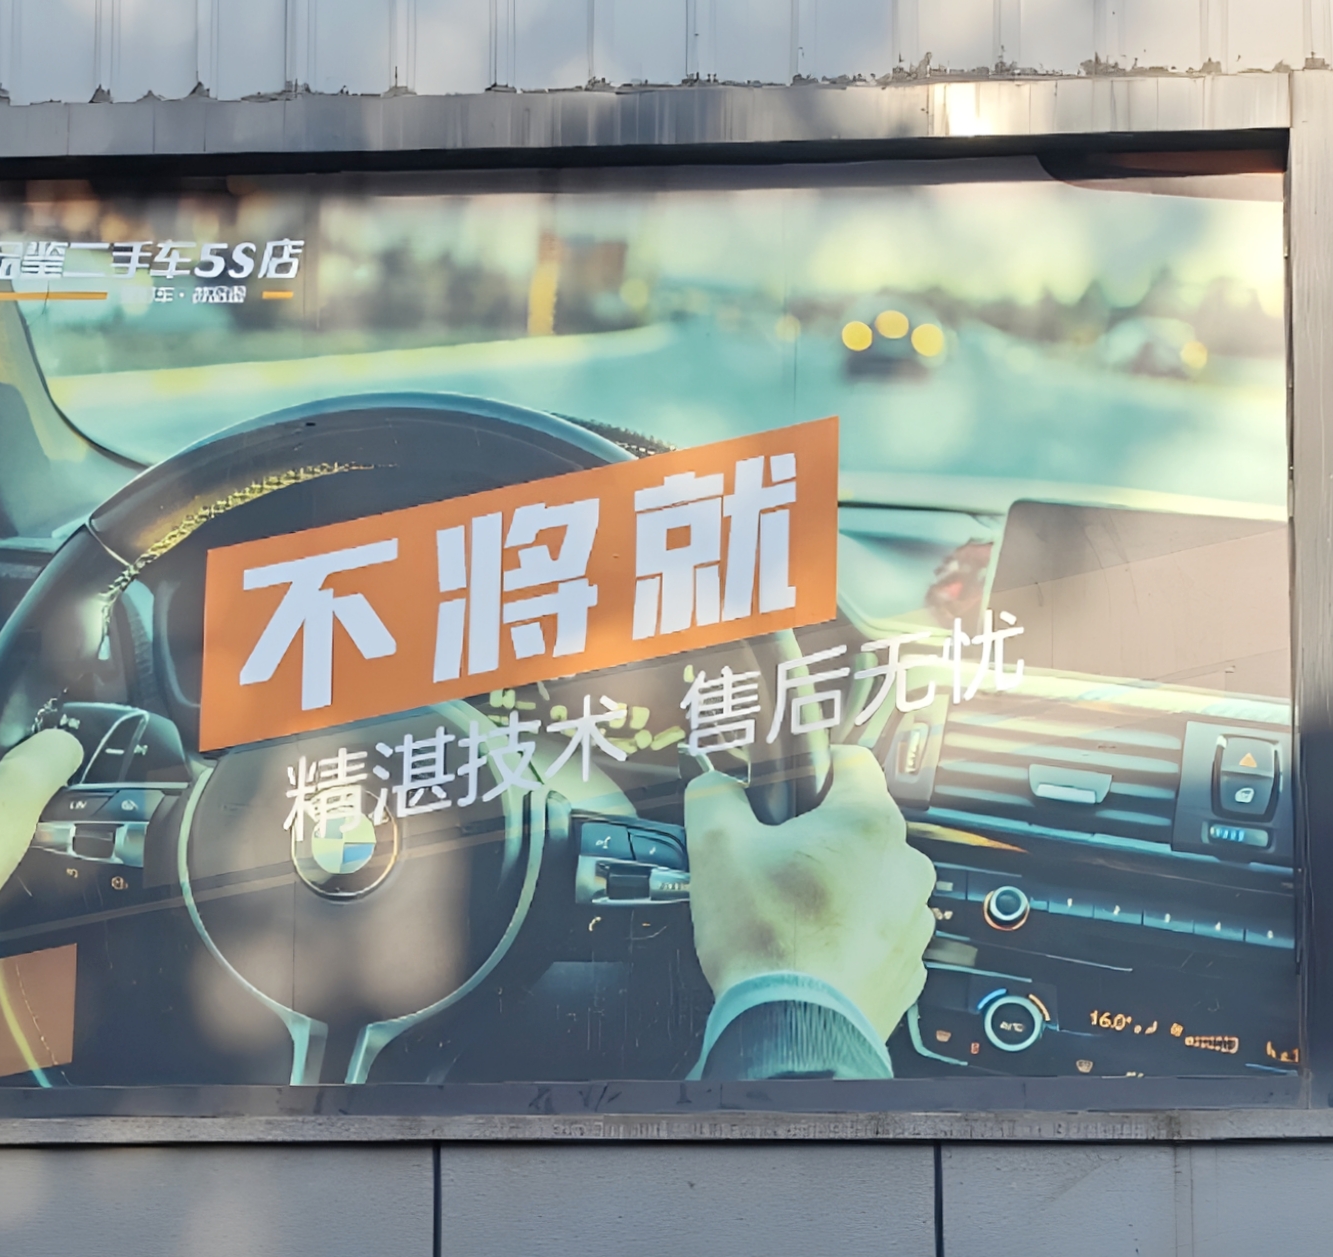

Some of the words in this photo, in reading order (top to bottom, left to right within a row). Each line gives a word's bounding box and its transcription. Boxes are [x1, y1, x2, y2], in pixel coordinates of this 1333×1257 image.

[238, 451, 798, 712] 不将就
[284, 692, 630, 842] 精湛技术
[678, 608, 1026, 758] 售后无忧
